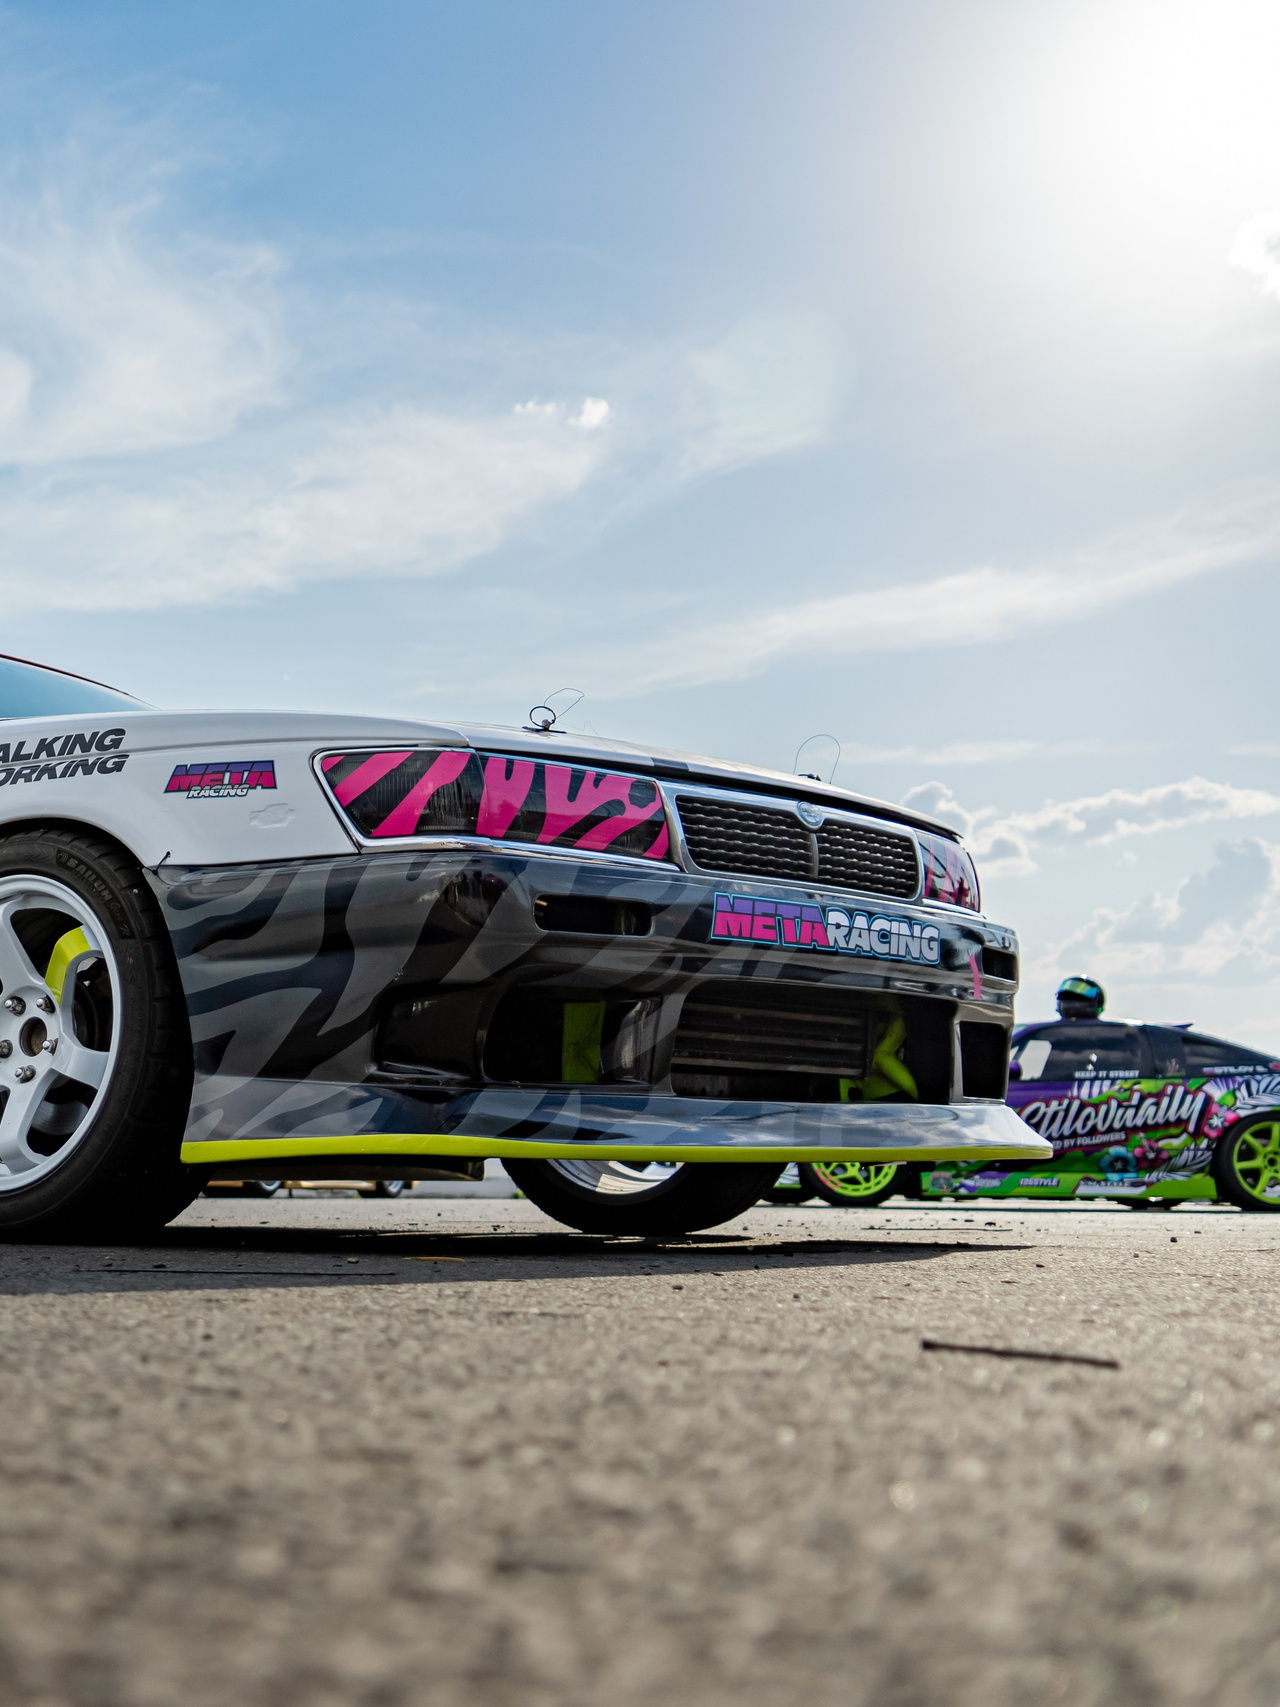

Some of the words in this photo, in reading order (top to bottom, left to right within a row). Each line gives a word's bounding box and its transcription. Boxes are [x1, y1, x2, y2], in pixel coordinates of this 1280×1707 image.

[164, 760, 277, 793] META
[186, 784, 250, 799] RACING
[66, 856, 113, 901] SAILUN
[1074, 1070, 1096, 1079] KEEP
[1109, 1069, 1140, 1079] STREET
[1064, 1138, 1076, 1149] BY
[1077, 1131, 1126, 1147] FOLLOWERS
